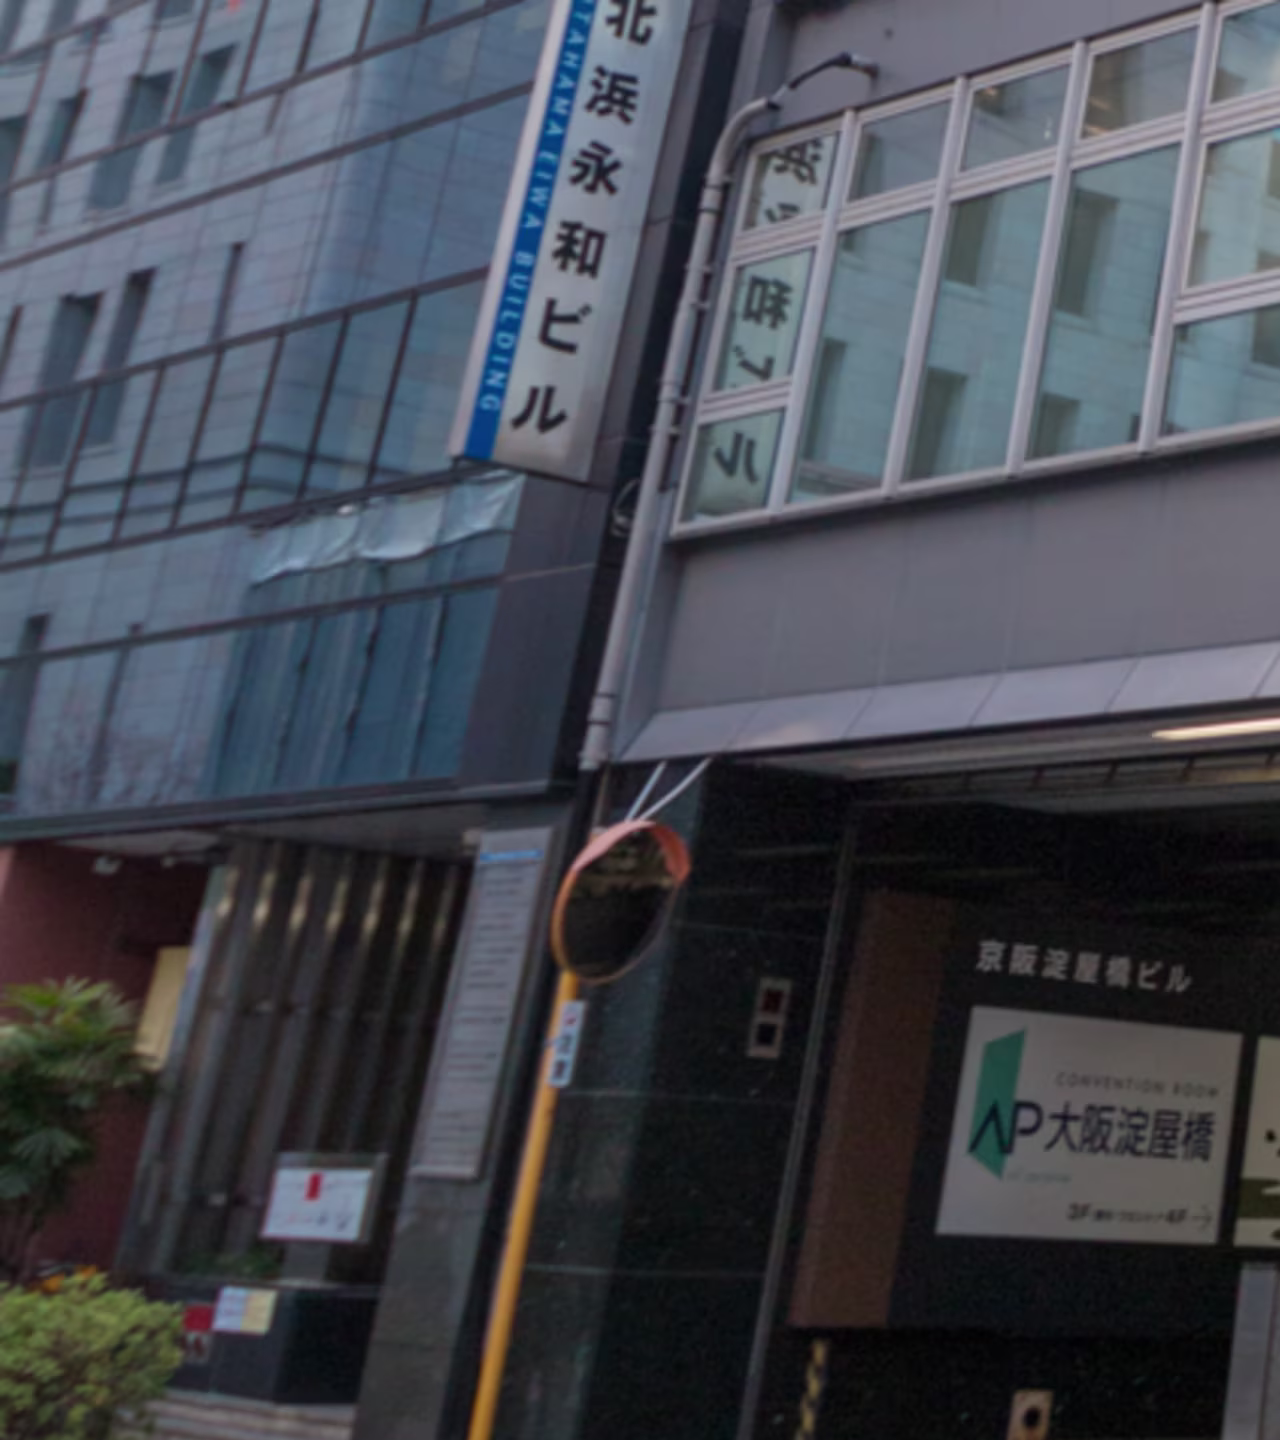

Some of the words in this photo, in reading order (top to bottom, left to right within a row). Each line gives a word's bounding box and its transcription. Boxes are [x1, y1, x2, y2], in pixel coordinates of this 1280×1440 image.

[512, 0, 657, 434] 北浜永和ビル
[521, 150, 560, 230] EIWA
[480, 251, 535, 412] BUILDING
[974, 939, 1193, 994] 京阪淀屋橋ビル
